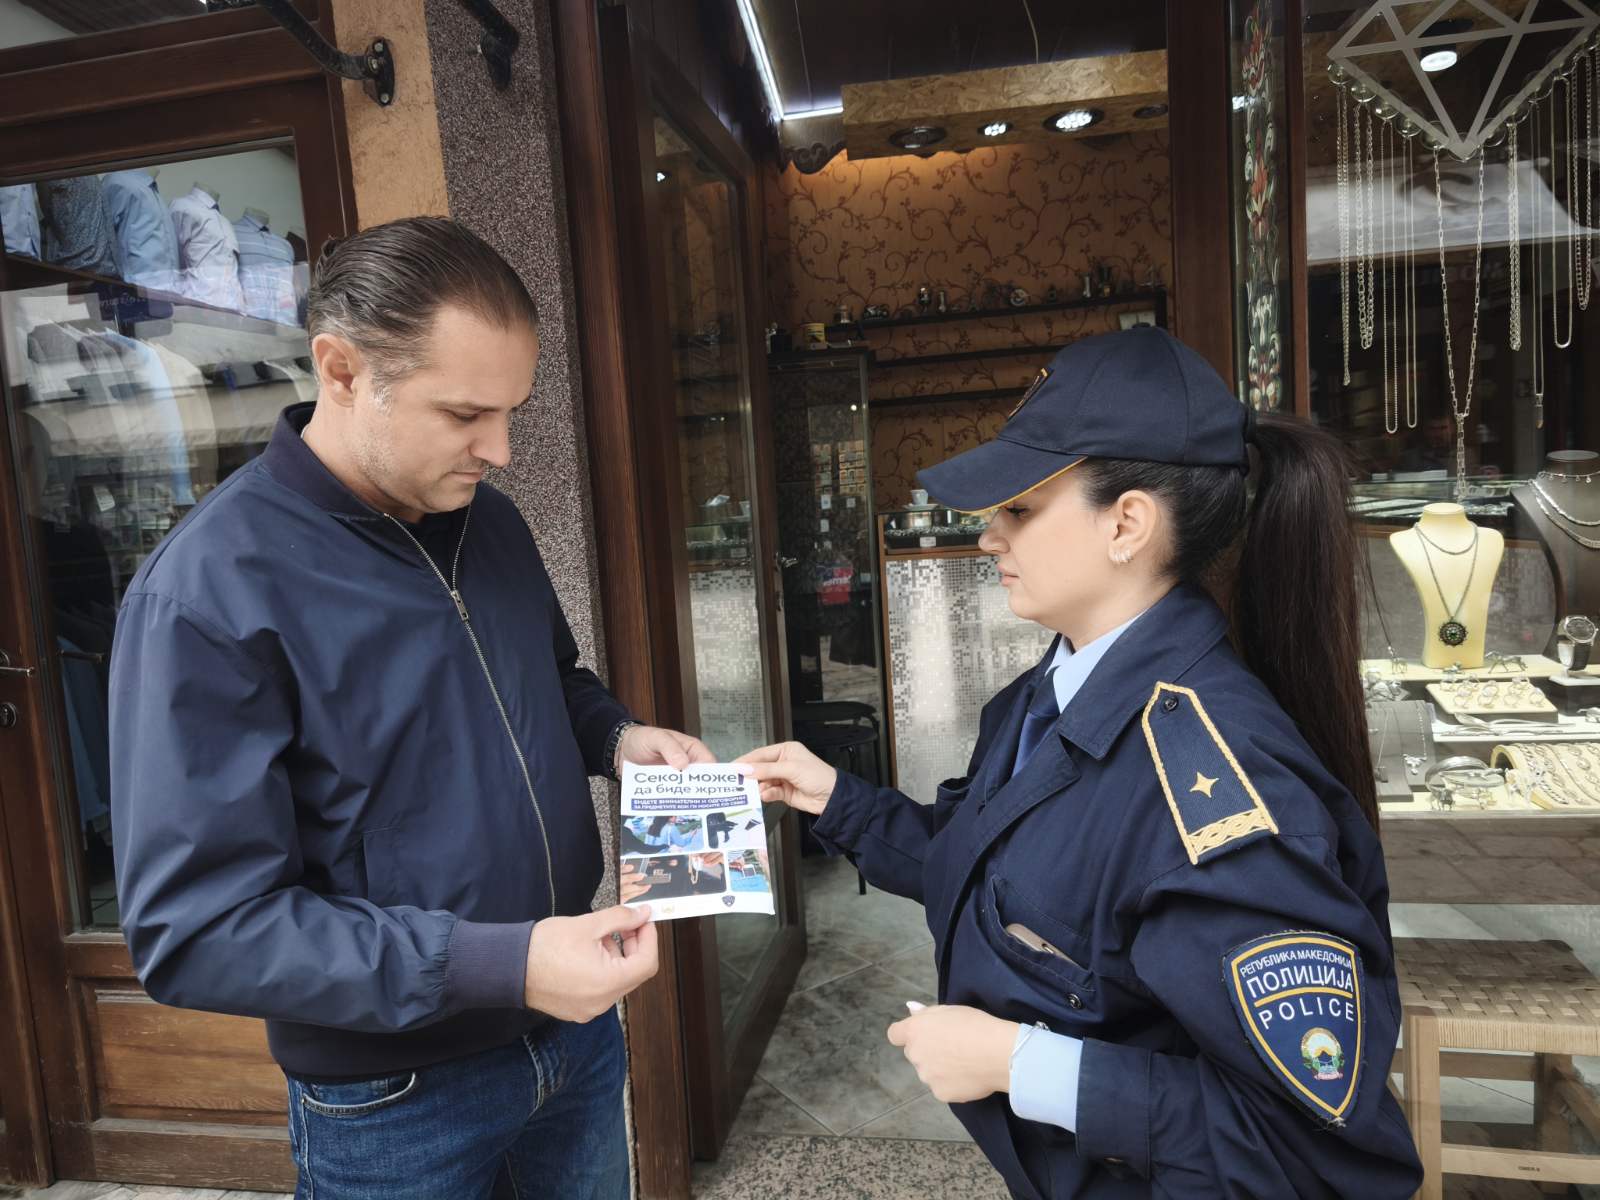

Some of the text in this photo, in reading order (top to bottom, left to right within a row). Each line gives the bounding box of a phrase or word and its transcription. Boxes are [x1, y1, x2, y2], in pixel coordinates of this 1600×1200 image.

[634, 769, 683, 785] Секој
[634, 786, 652, 796] да
[656, 783, 691, 796] биде
[1240, 949, 1353, 978] РЕПУБЛИКА МАКЕДОНИЈА
[1246, 965, 1354, 998] ПОЛИЦИЈА
[1258, 997, 1355, 1030] POLICE
